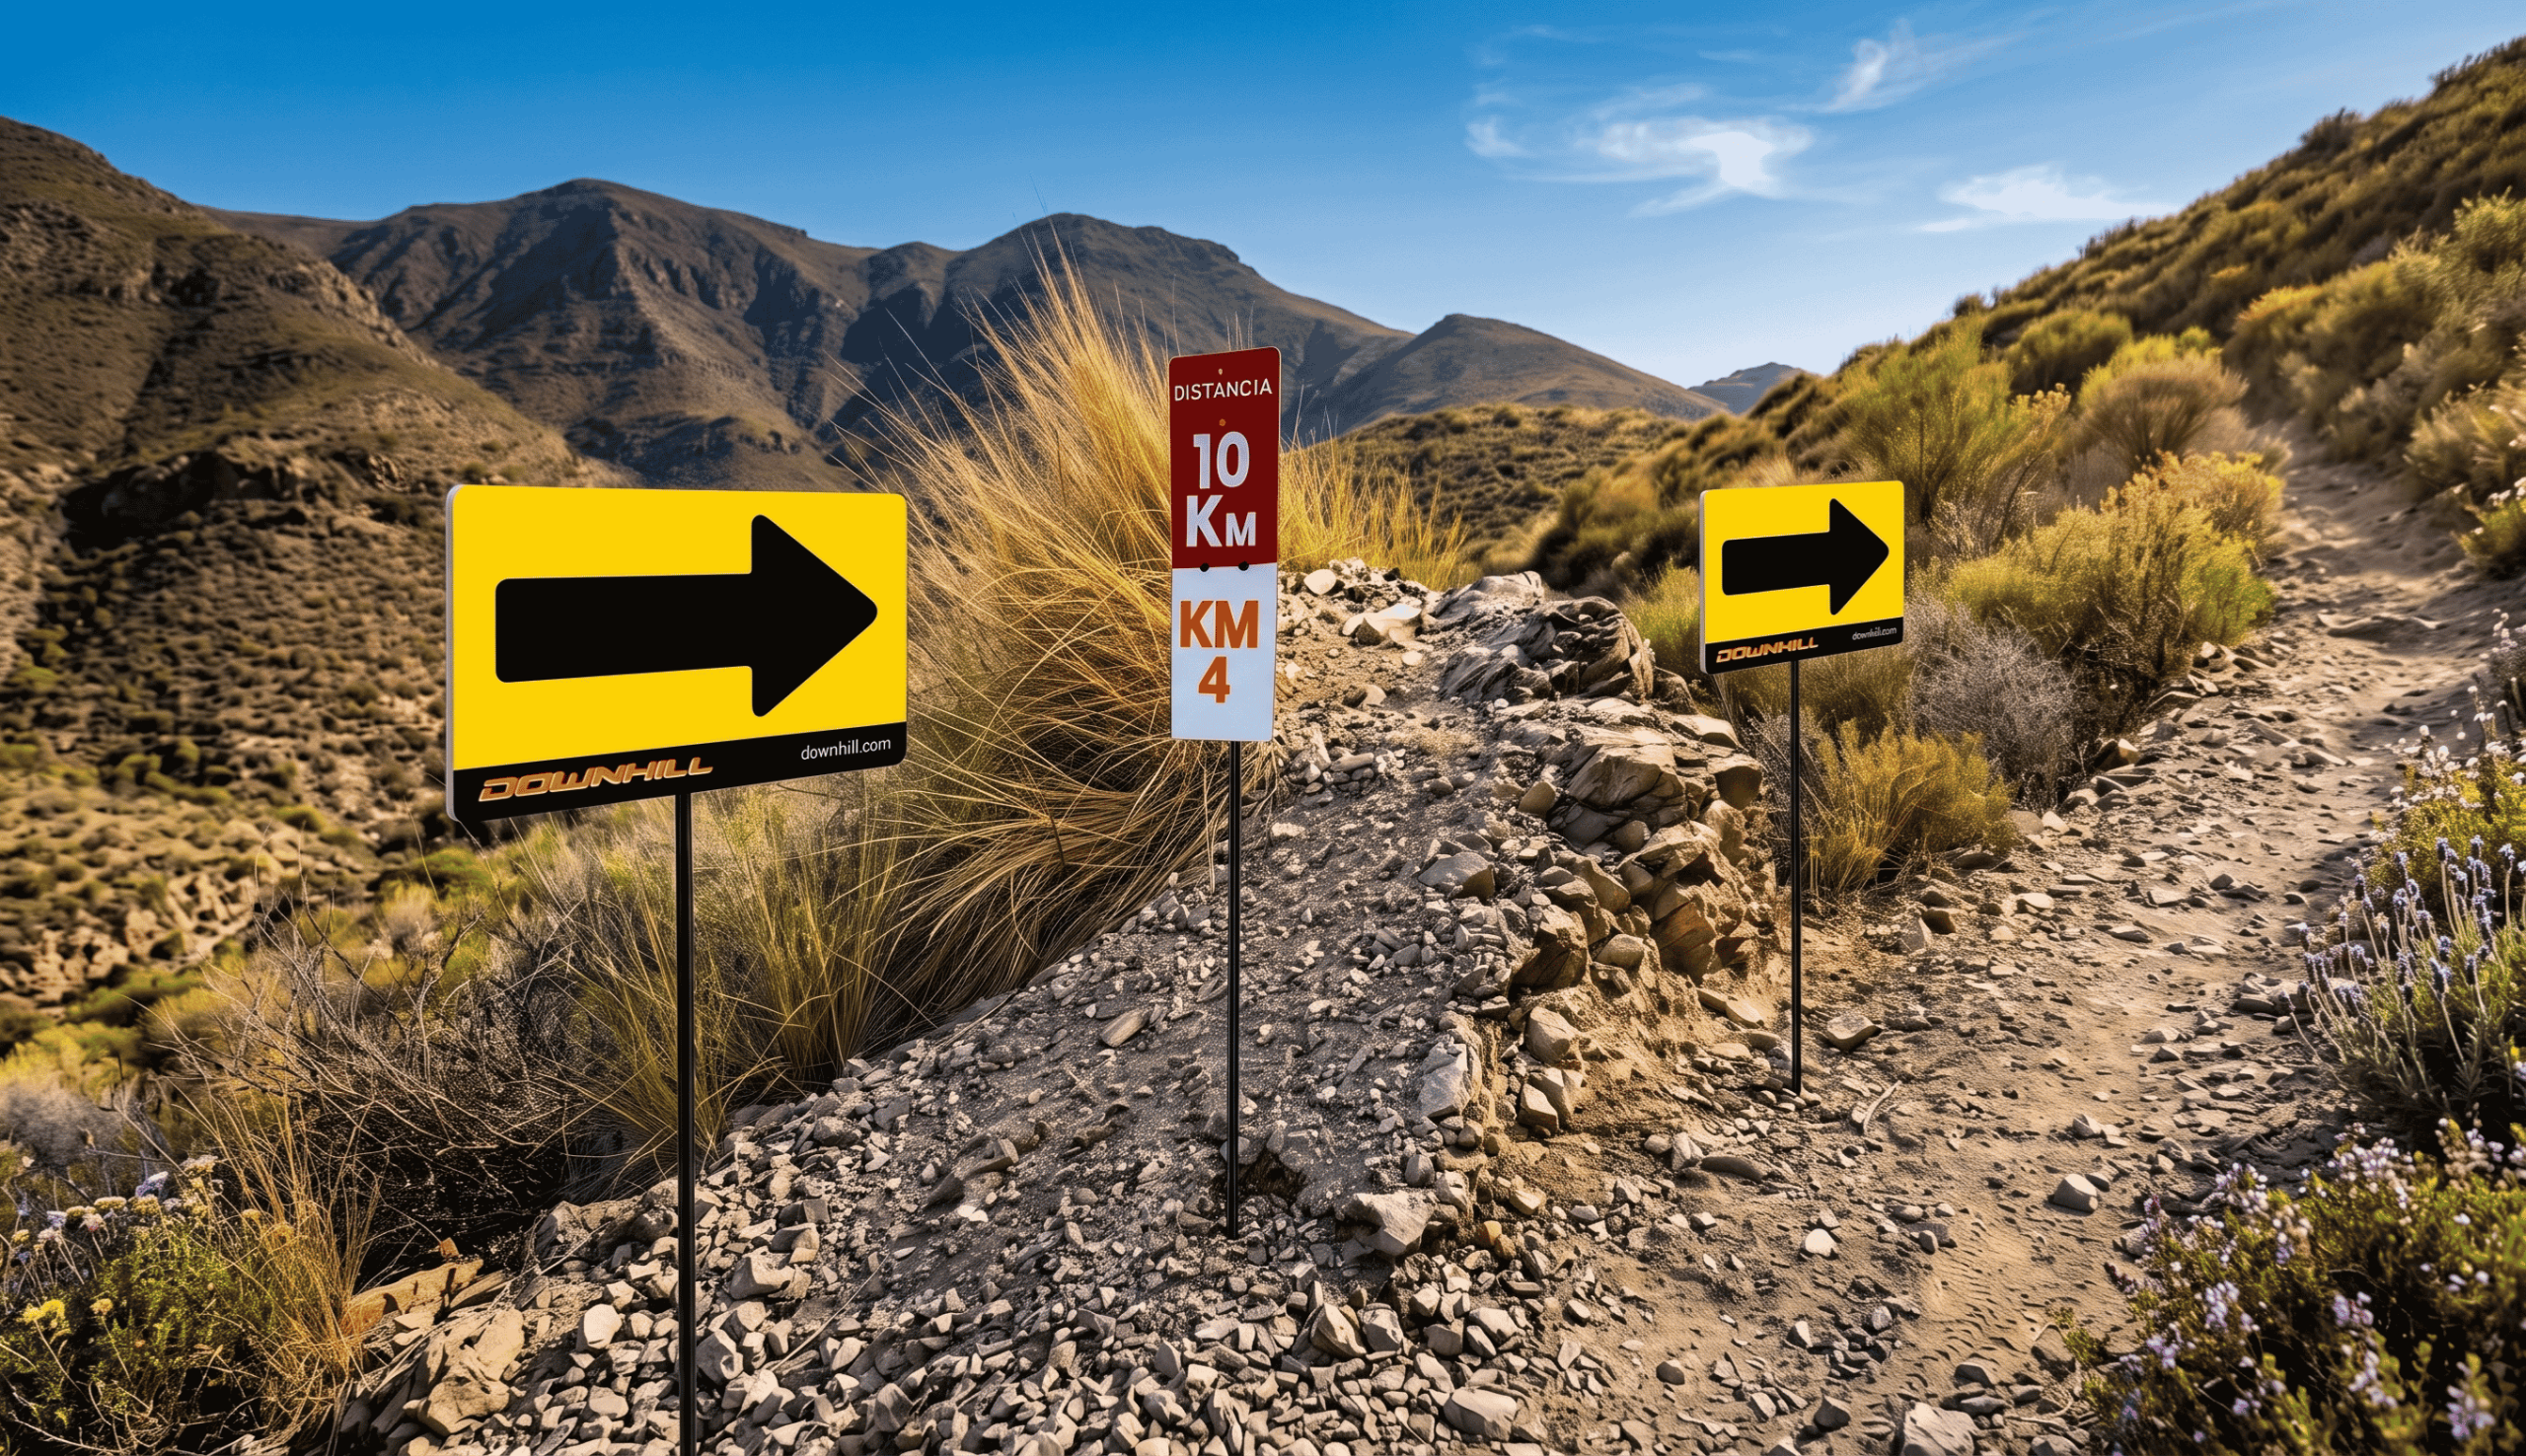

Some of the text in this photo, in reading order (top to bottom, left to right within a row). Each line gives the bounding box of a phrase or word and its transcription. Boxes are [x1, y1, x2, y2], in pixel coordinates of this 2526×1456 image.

[1174, 378, 1273, 401] DISTANCIA
[1192, 431, 1250, 489] 10
[1179, 600, 1259, 649] KM
[1715, 637, 1820, 663] DOWNHILL
[1197, 656, 1230, 703] 4
[800, 737, 892, 761] downhill.com
[478, 757, 713, 803] DOWNHILL
